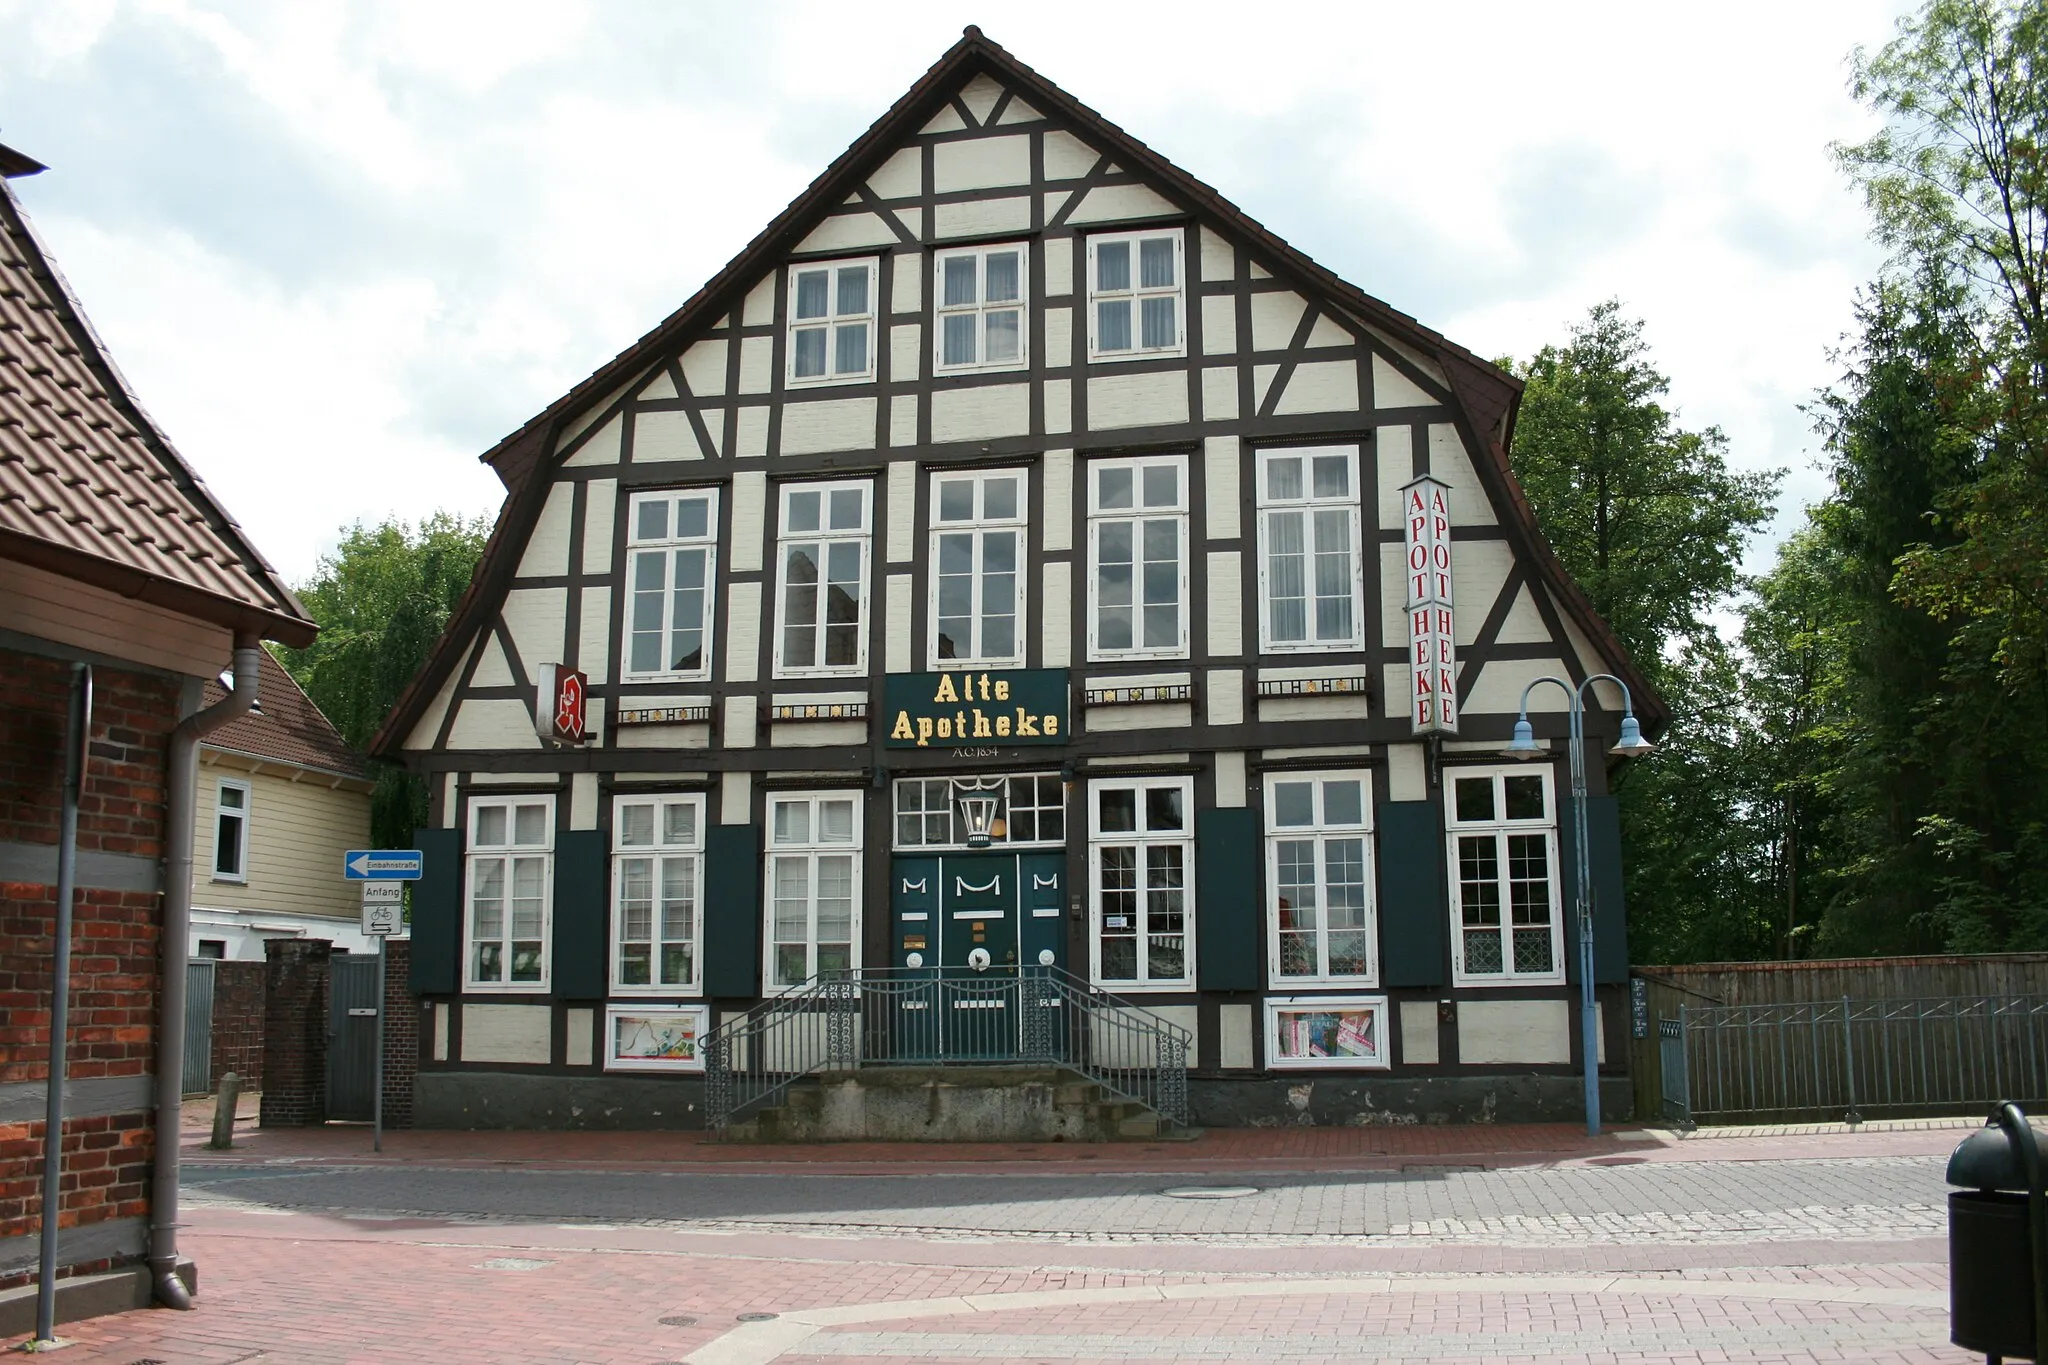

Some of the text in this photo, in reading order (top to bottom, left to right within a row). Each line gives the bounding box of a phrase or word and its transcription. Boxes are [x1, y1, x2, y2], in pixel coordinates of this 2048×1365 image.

[1408, 489, 1432, 725] APOTHEKE
[1432, 488, 1454, 725] APOTHEKE
[934, 673, 1010, 702] Alte
[891, 707, 1058, 746] Apotheke
[366, 887, 400, 898] Anfang
